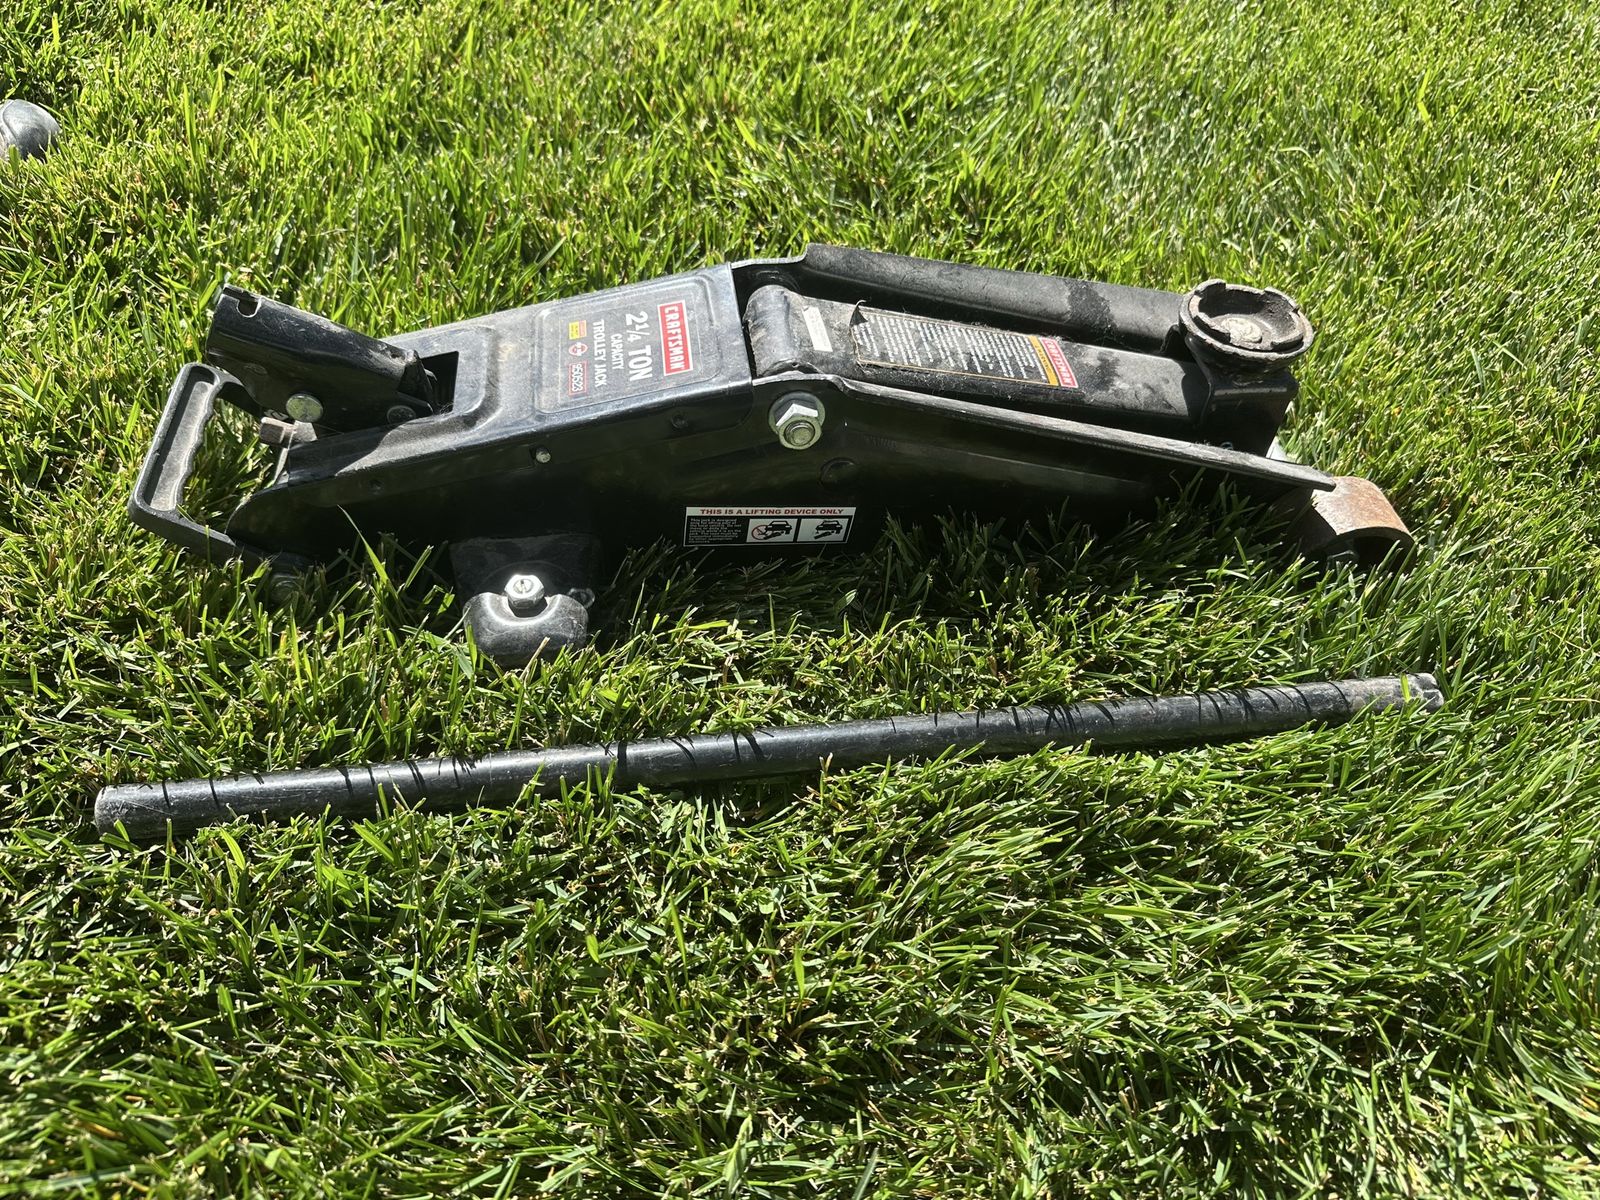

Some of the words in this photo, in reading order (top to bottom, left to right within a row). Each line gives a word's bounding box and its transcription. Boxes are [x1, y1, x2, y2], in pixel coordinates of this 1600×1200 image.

[592, 319, 607, 362] TROLLEY
[610, 333, 625, 370] CAPACITY
[664, 305, 686, 370] CRAFTSMAN
[594, 364, 607, 388] JACK
[628, 345, 653, 381] TON
